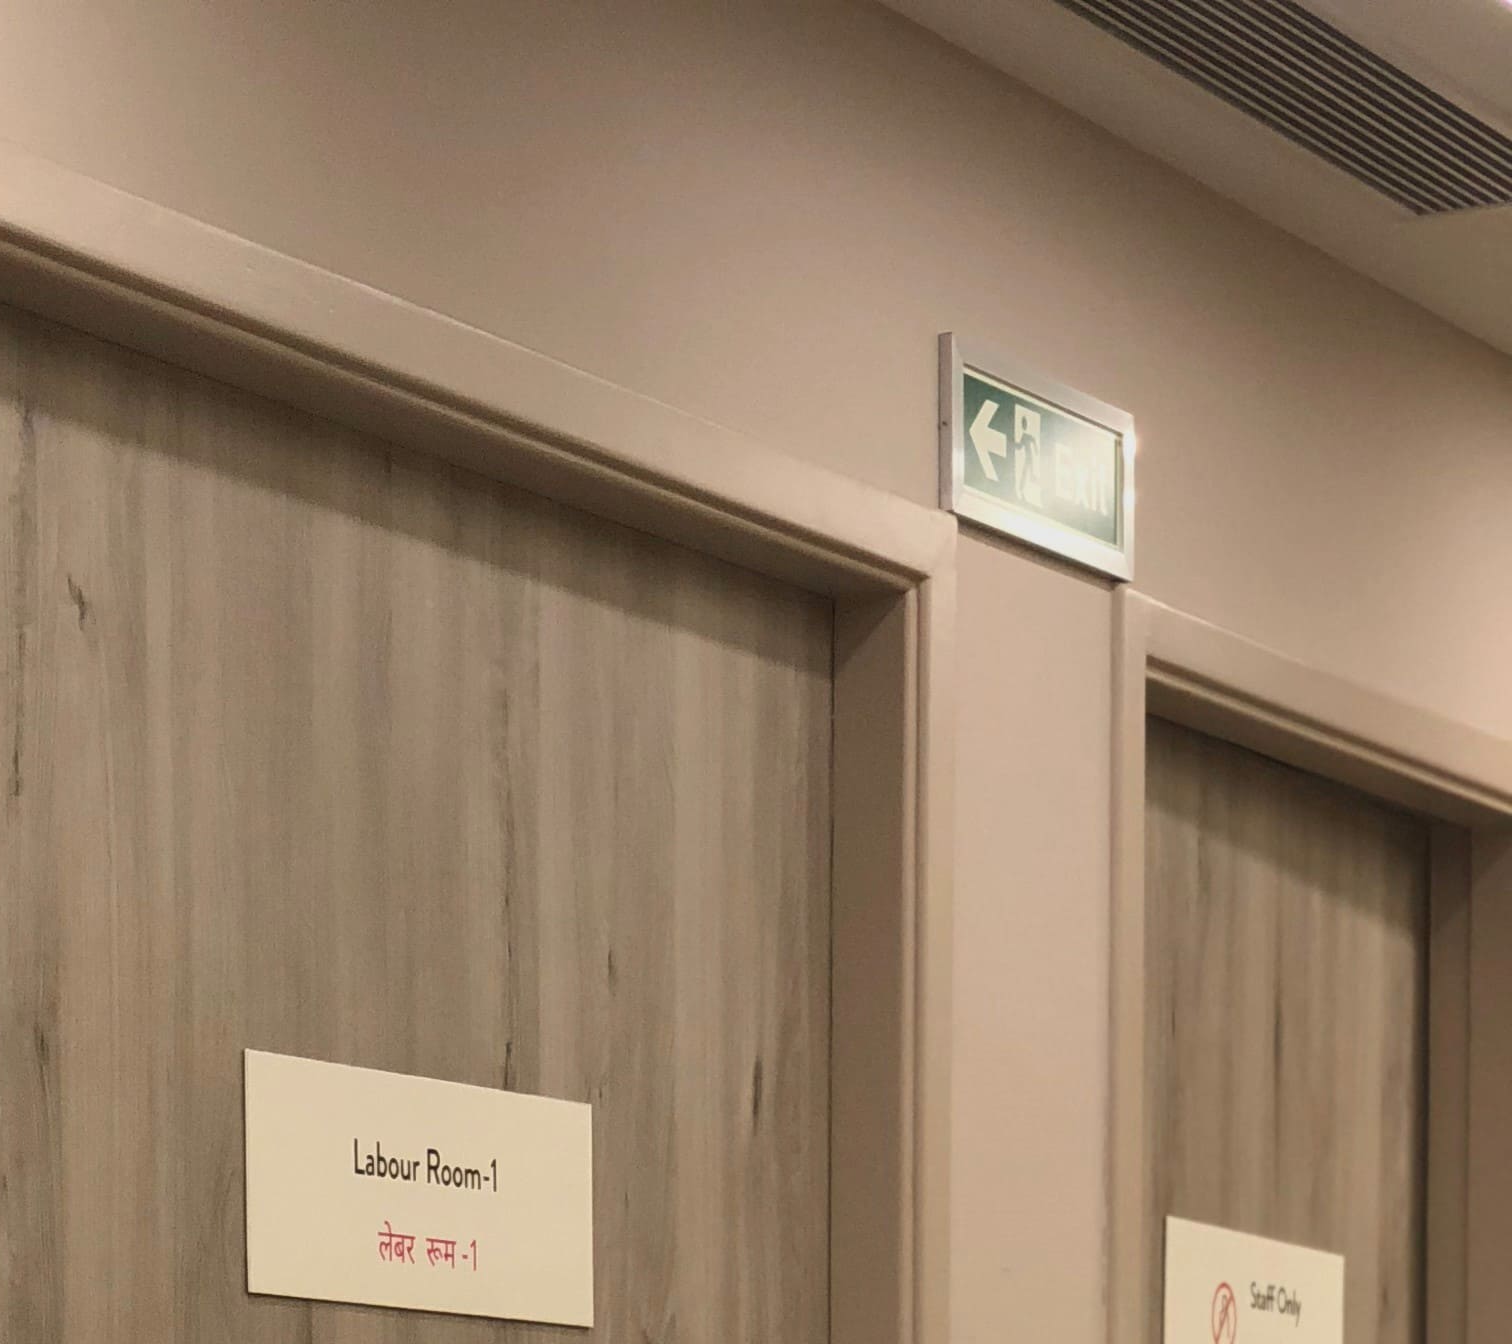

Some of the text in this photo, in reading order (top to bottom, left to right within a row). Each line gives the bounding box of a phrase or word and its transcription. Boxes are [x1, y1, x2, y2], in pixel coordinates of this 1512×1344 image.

[353, 1138, 497, 1193] Labour Room-1
[378, 1221, 416, 1264] लेबर
[1250, 1281, 1302, 1328] Staff Only
